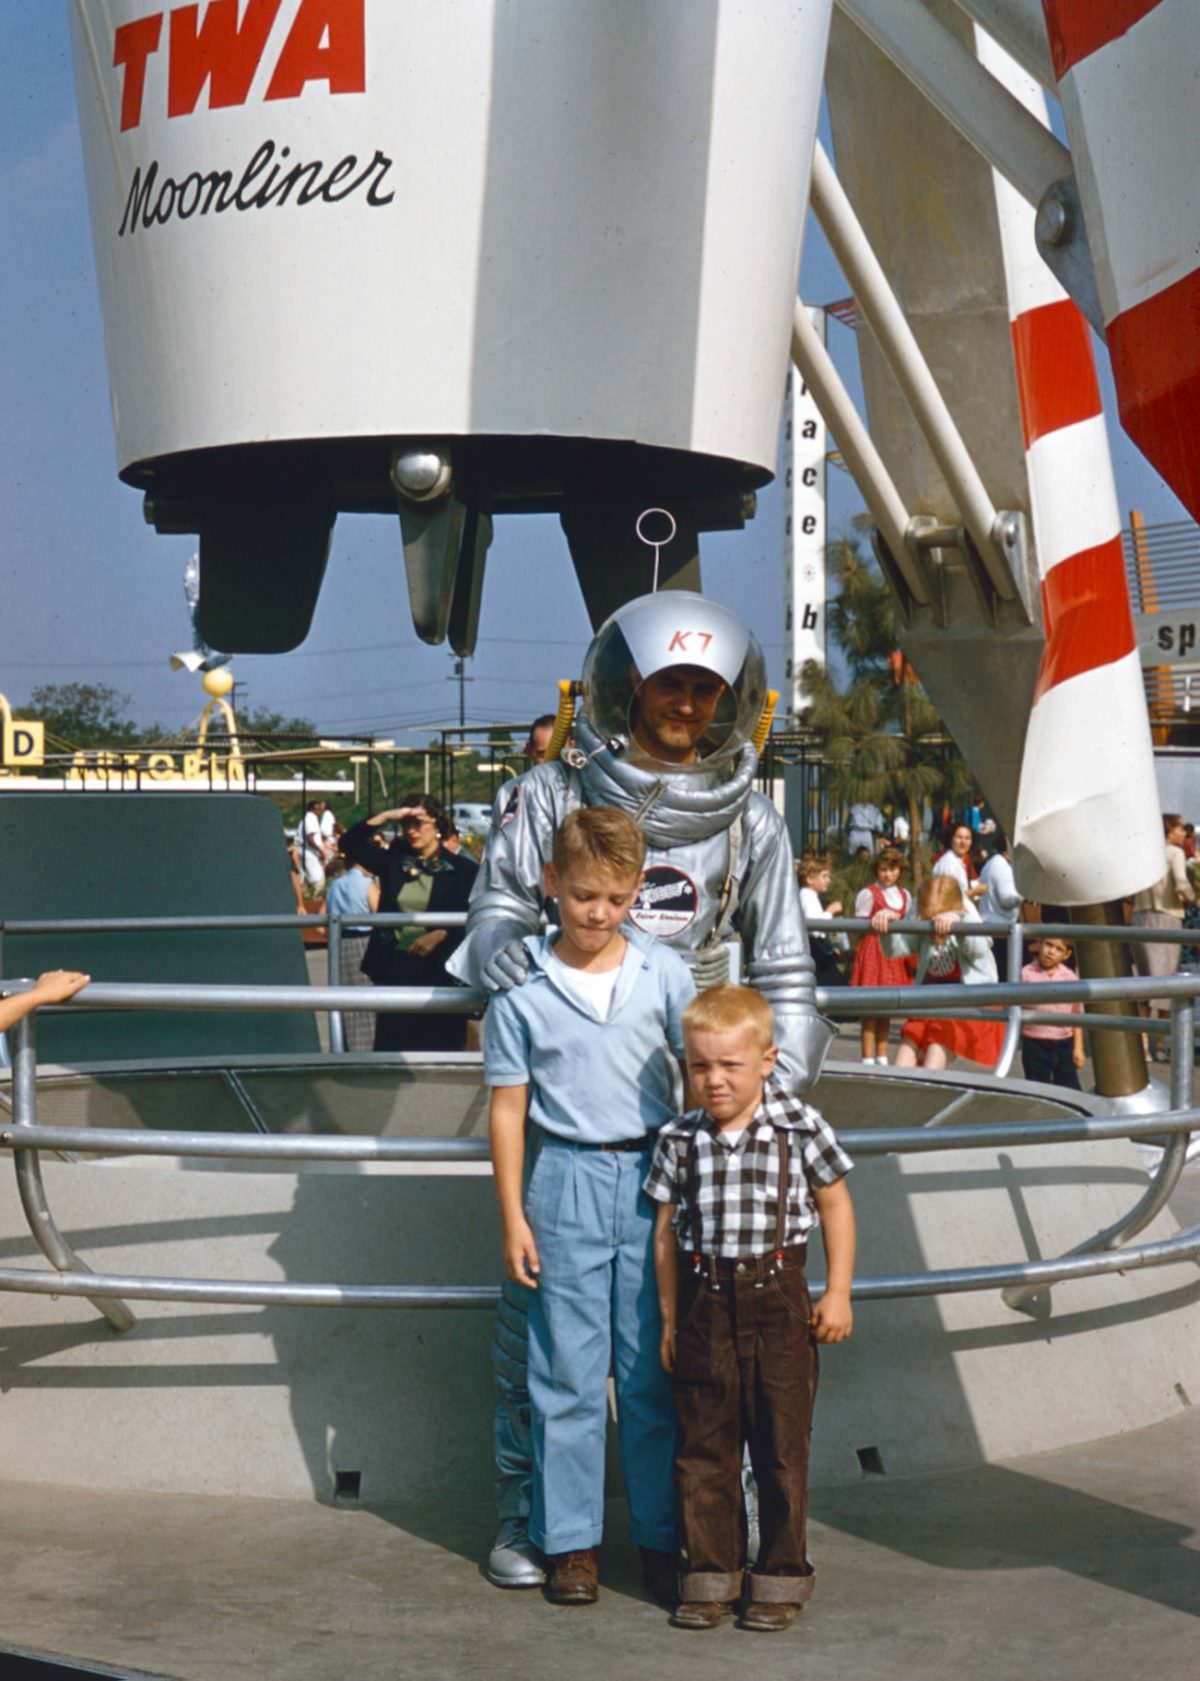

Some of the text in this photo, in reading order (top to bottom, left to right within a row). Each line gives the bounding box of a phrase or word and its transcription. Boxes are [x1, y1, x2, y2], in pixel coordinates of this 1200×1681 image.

[113, 0, 366, 133] TWA
[118, 139, 395, 236] Moonliner
[668, 631, 713, 653] K7
